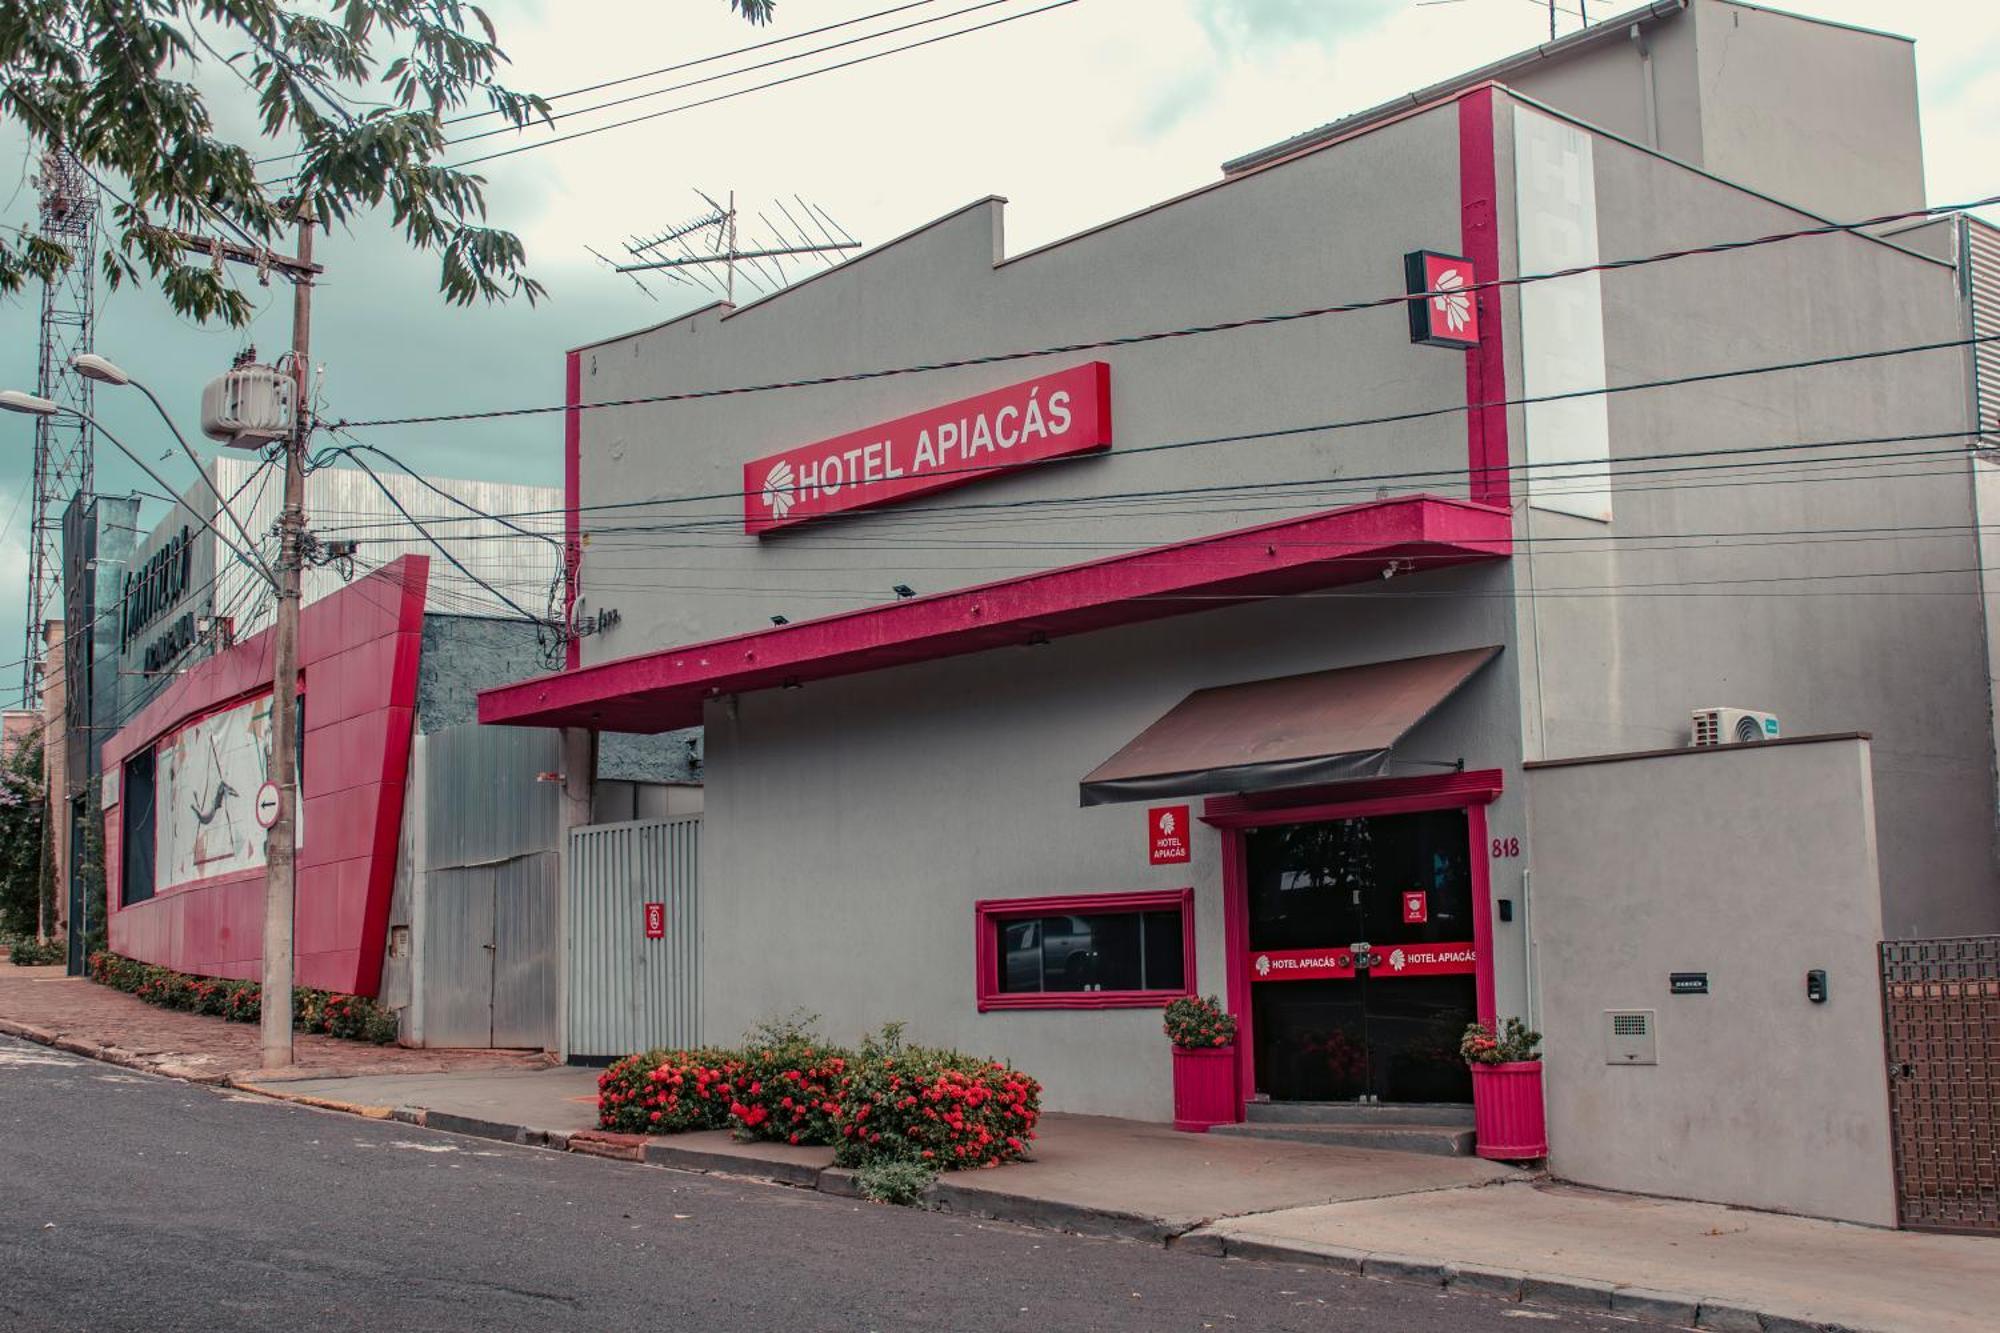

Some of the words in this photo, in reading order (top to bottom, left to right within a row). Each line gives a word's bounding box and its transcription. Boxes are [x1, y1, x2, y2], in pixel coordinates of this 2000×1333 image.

[800, 440, 903, 502] HOTEL
[912, 386, 1072, 473] APIACÁS
[1157, 837, 1182, 848] HOTEL
[1492, 838, 1519, 858] 818
[1154, 846, 1186, 858] APIACÁS
[1272, 959, 1299, 969] HOTEL
[1299, 955, 1336, 969] APIACÁS
[1407, 952, 1437, 963] HOTEL
[1438, 948, 1477, 963] APIACÁS
